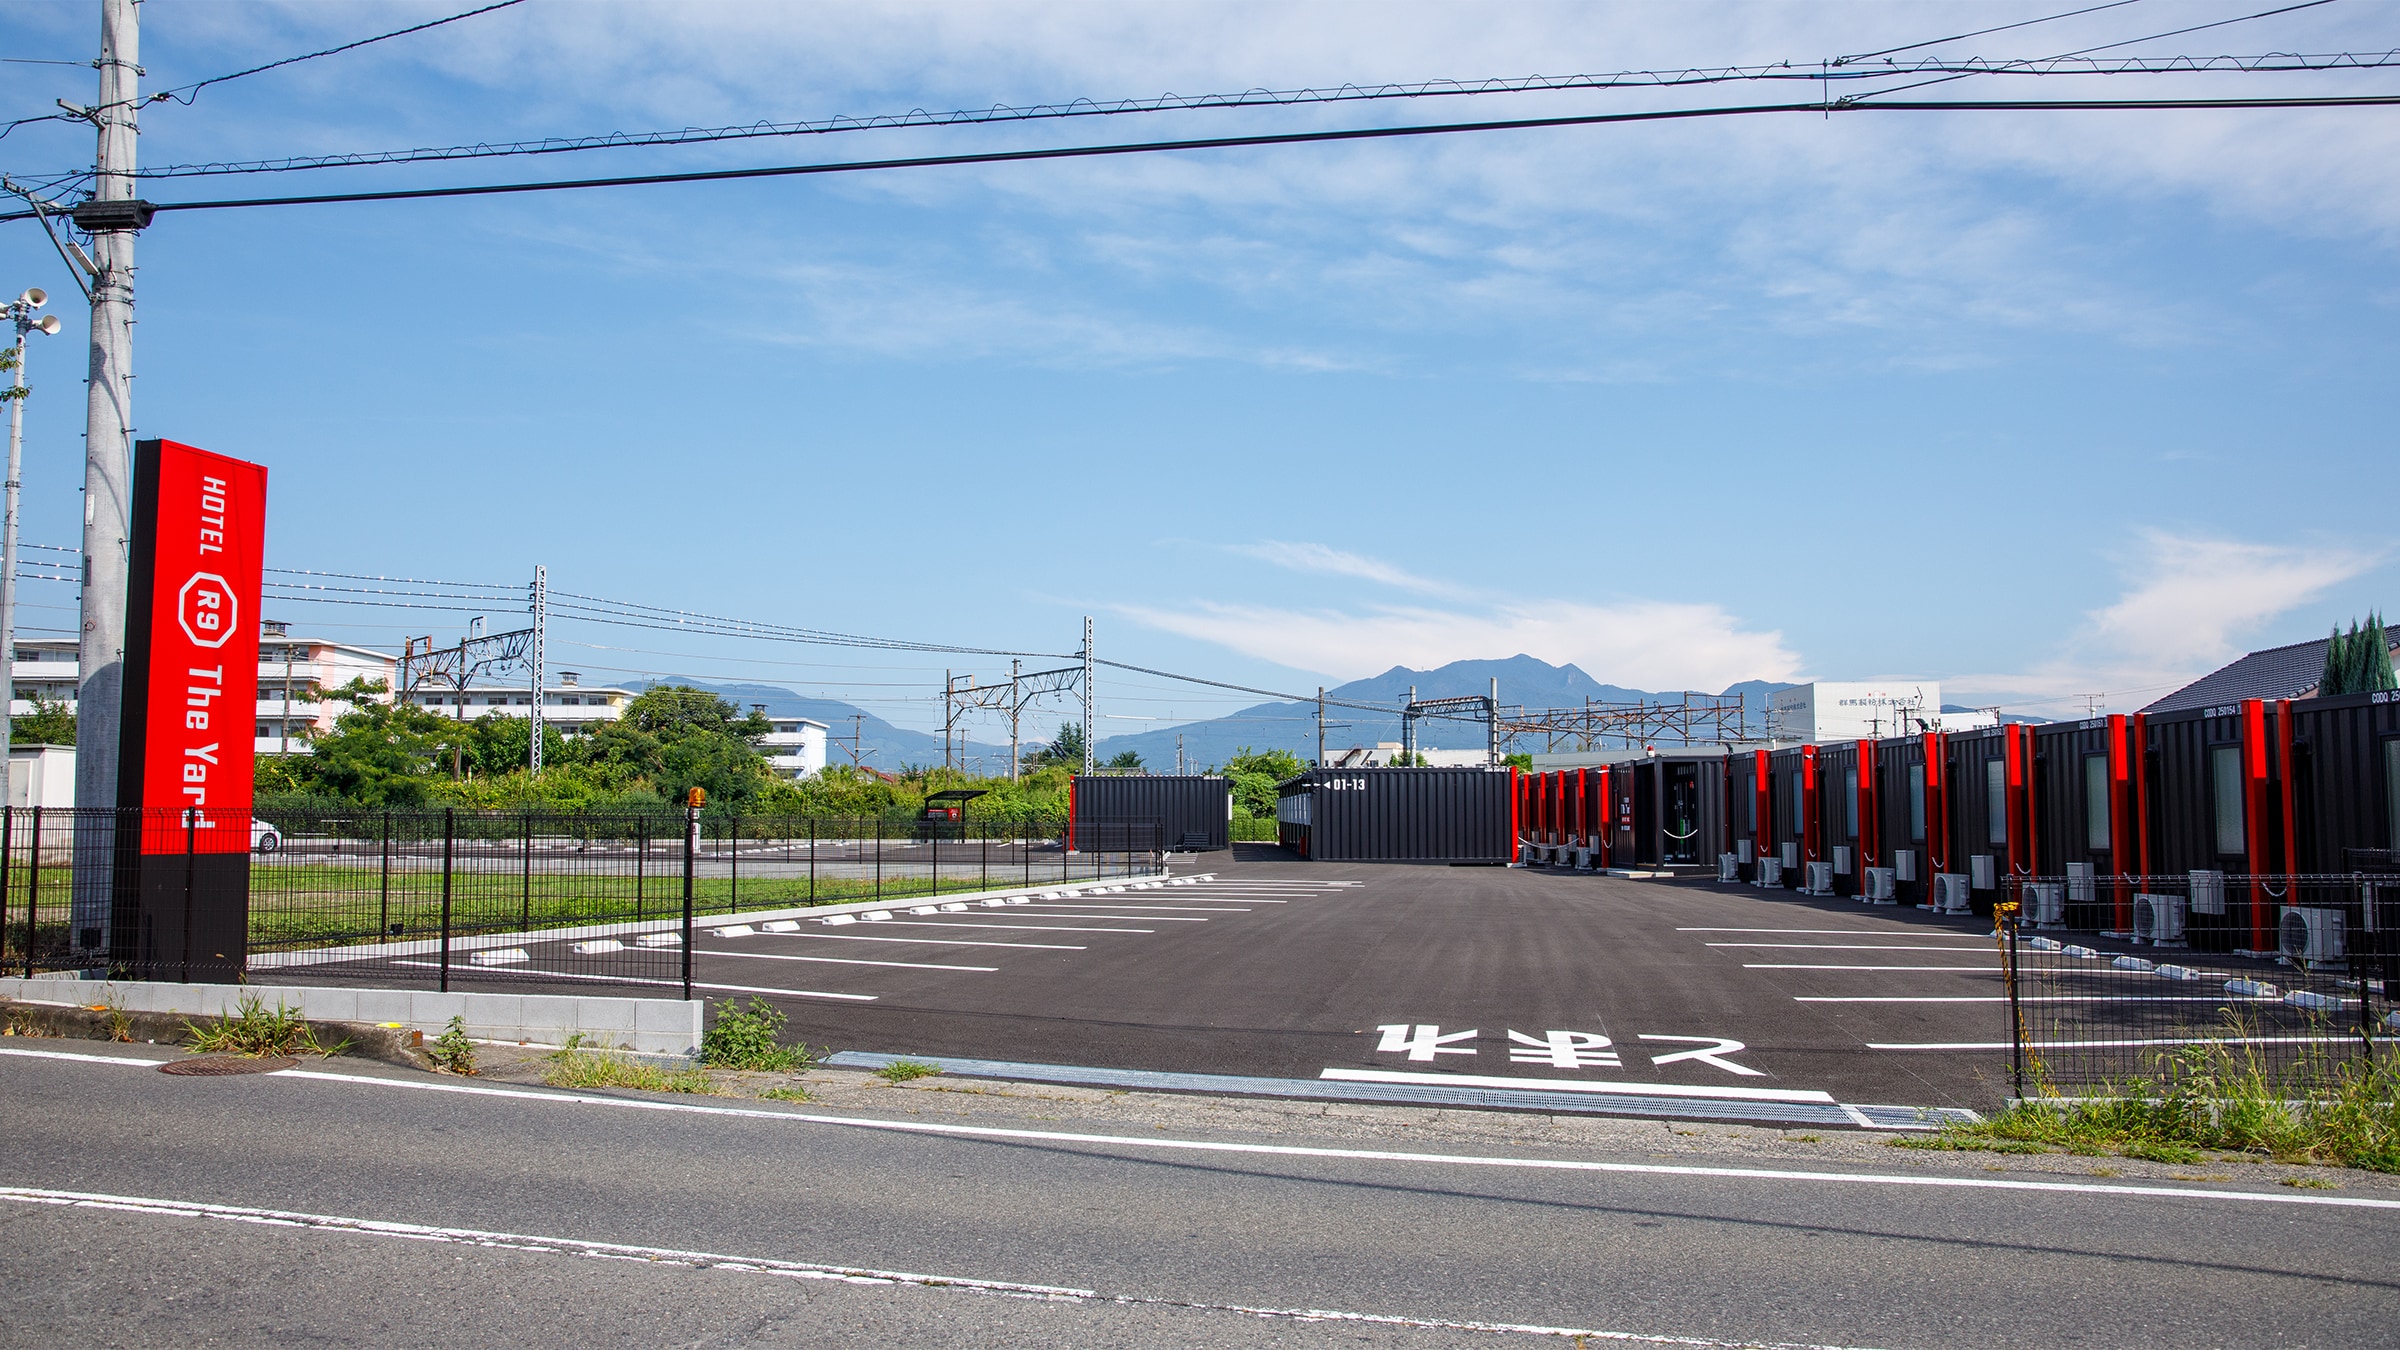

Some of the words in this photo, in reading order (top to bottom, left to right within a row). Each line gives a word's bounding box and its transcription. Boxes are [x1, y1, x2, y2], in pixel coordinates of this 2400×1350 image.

[199, 476, 226, 555] HOTEL
[196, 589, 221, 631] R9
[186, 665, 223, 730] The
[181, 742, 219, 828] Yard
[1333, 778, 1365, 791] 01-13
[1377, 1024, 1766, 1076] とまれ
